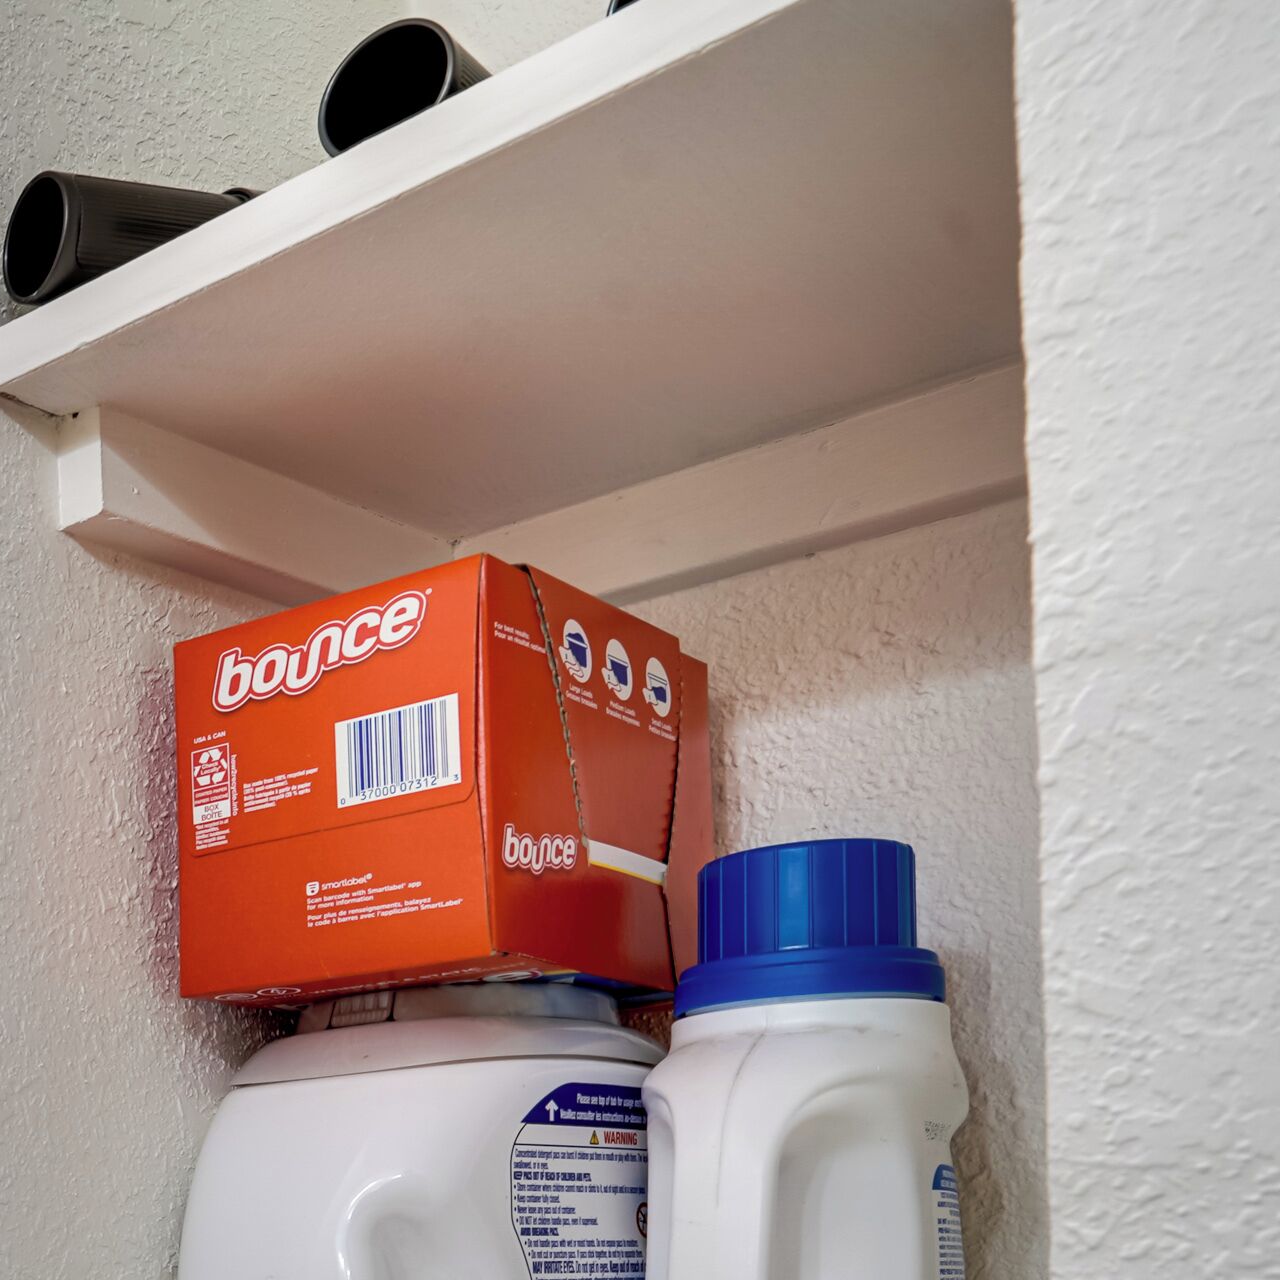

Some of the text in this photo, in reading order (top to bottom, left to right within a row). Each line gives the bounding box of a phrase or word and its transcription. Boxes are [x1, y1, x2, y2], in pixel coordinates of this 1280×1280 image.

[214, 592, 425, 711] bounce
[193, 735, 207, 744] USA
[212, 730, 226, 740] CAN
[360, 783, 397, 801] 37000
[399, 775, 438, 792] 07312
[453, 773, 459, 782] 3
[204, 803, 219, 813] BOX
[502, 823, 578, 875] bounce
[307, 897, 323, 905] Scan
[323, 892, 350, 902] barcode
[351, 889, 366, 897] with
[407, 880, 422, 889] app
[335, 895, 374, 906] information
[603, 1130, 638, 1146] WARNING
